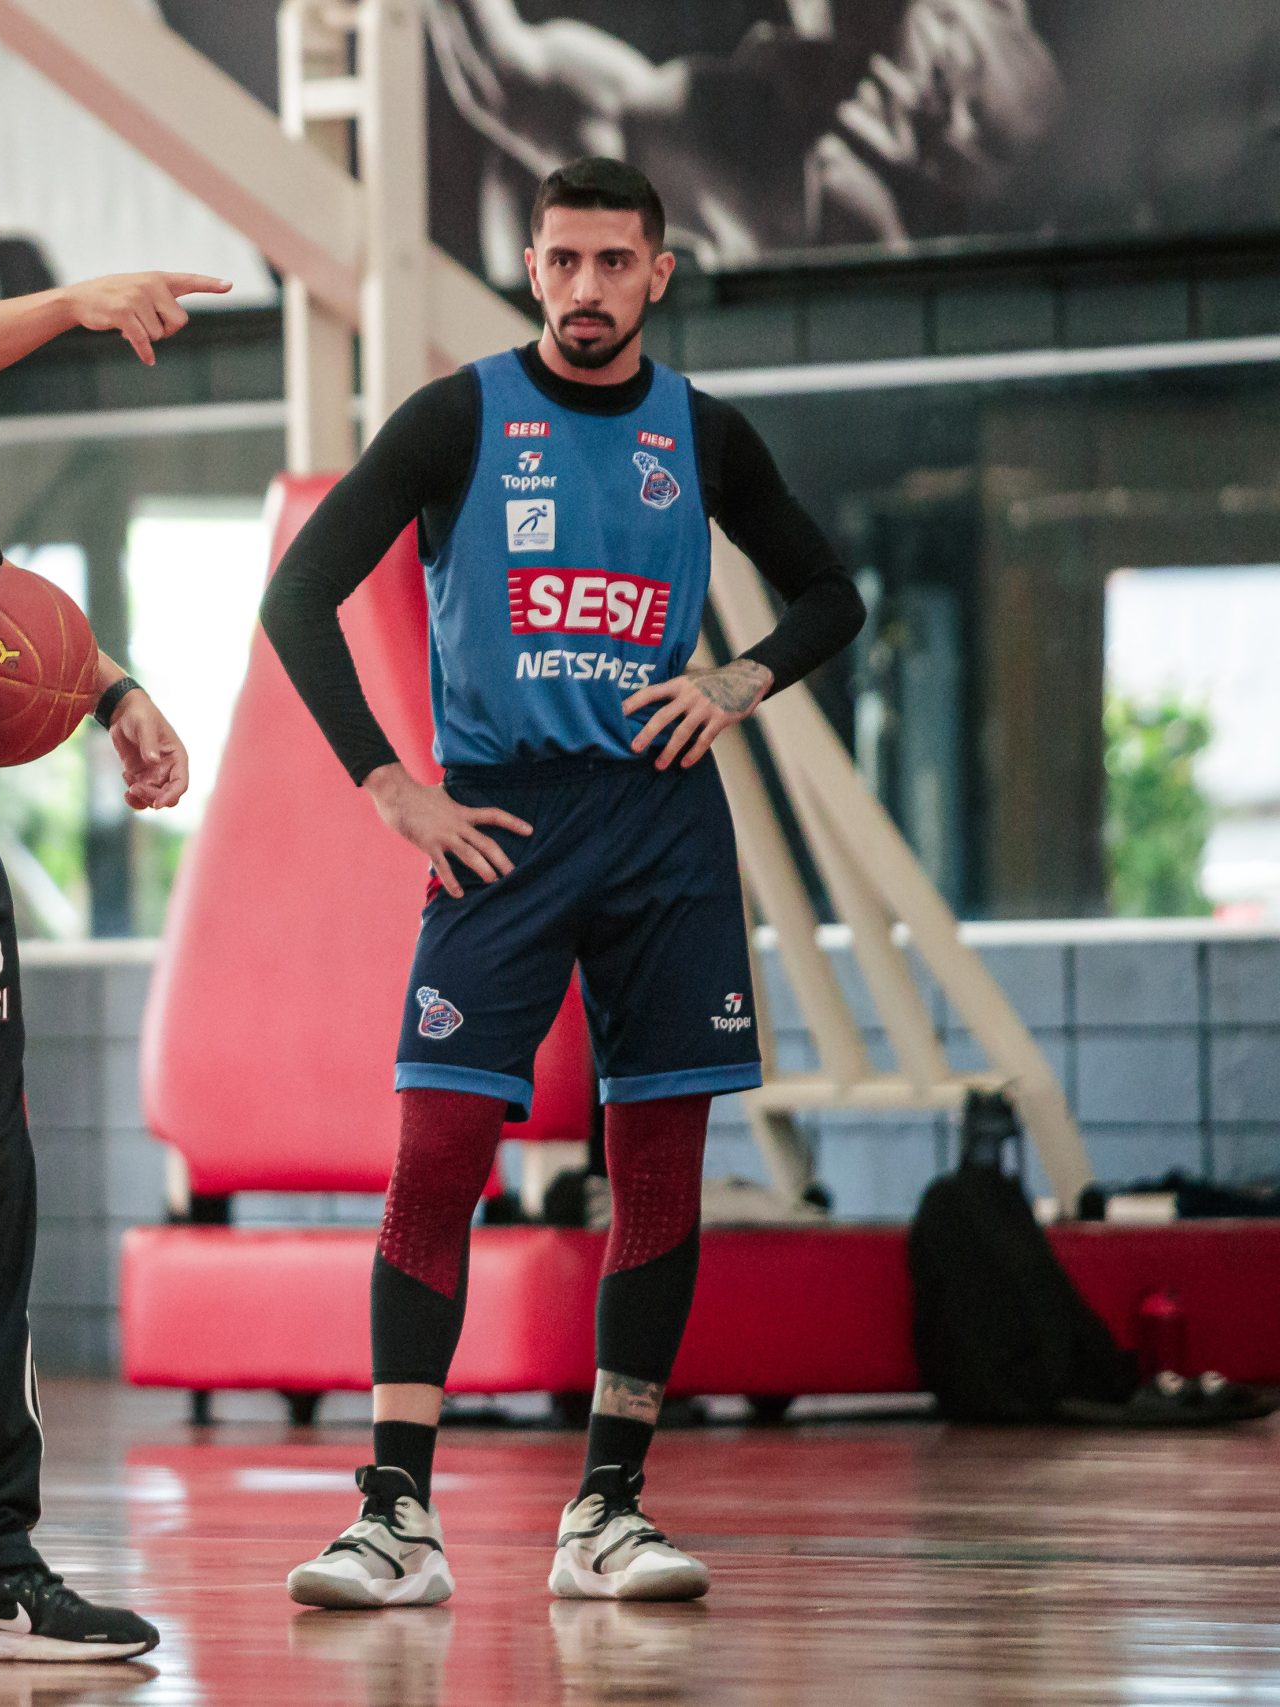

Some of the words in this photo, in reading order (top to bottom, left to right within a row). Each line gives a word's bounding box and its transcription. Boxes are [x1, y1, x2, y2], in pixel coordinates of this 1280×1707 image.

[508, 422, 546, 436] SESI
[640, 431, 673, 448] FIESP
[501, 474, 557, 491] Topper
[527, 574, 655, 638] SESI
[516, 649, 656, 689] NETSHES
